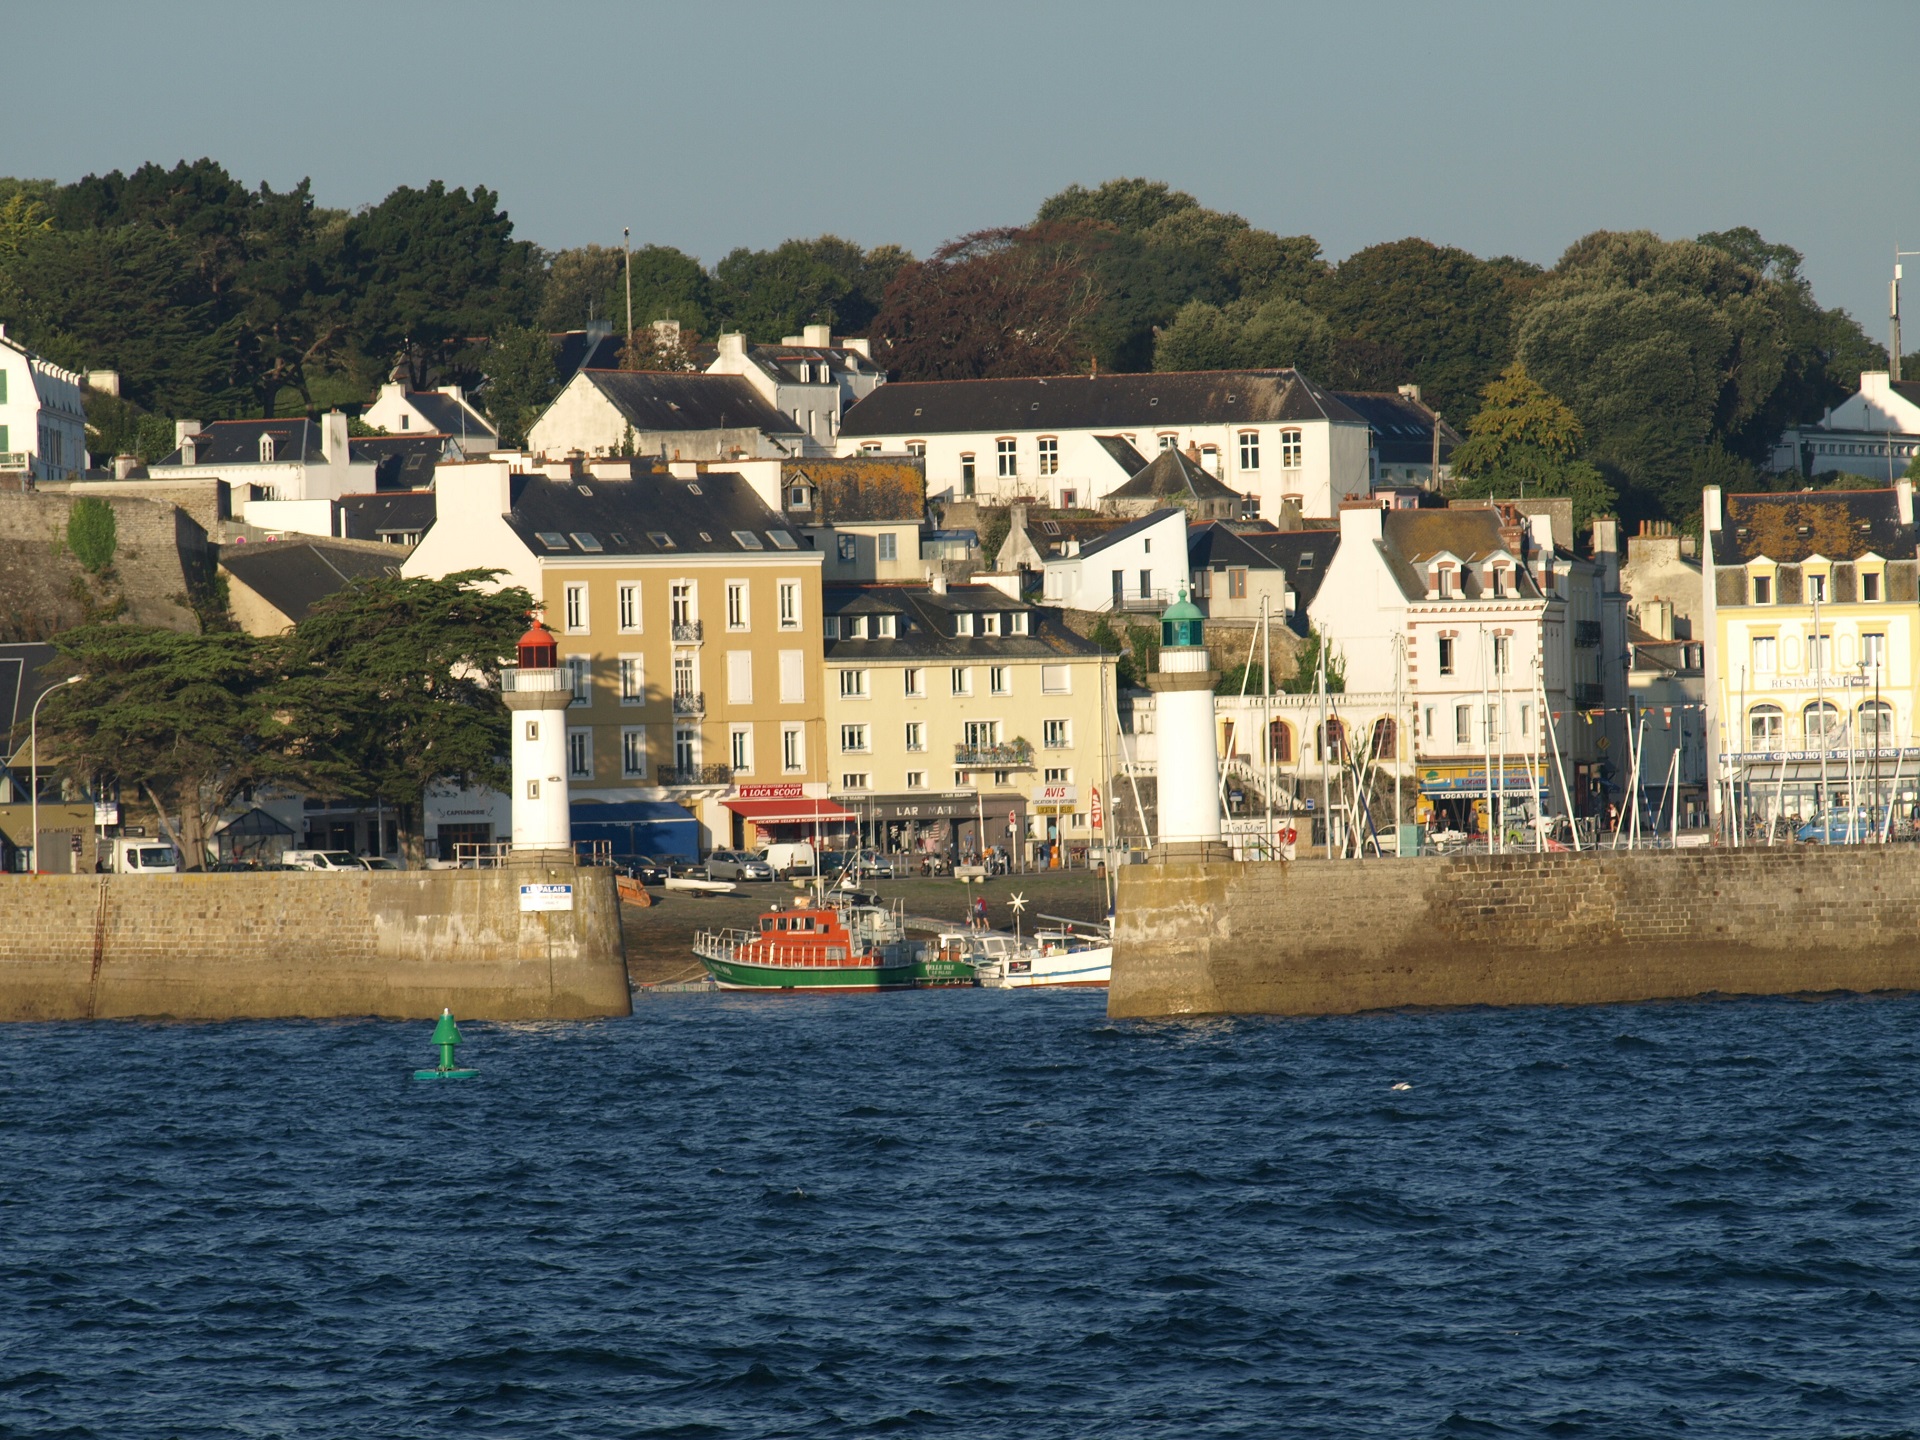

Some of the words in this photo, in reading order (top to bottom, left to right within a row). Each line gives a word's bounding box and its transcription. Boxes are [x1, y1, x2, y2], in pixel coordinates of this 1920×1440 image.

[1771, 677, 1841, 688] RESTAURANT
[741, 789, 747, 797] A
[750, 789, 770, 797] LOCA
[774, 788, 801, 796] SCOOT
[1044, 787, 1065, 798] AVIS
[1441, 792, 1480, 800] LOCATION
